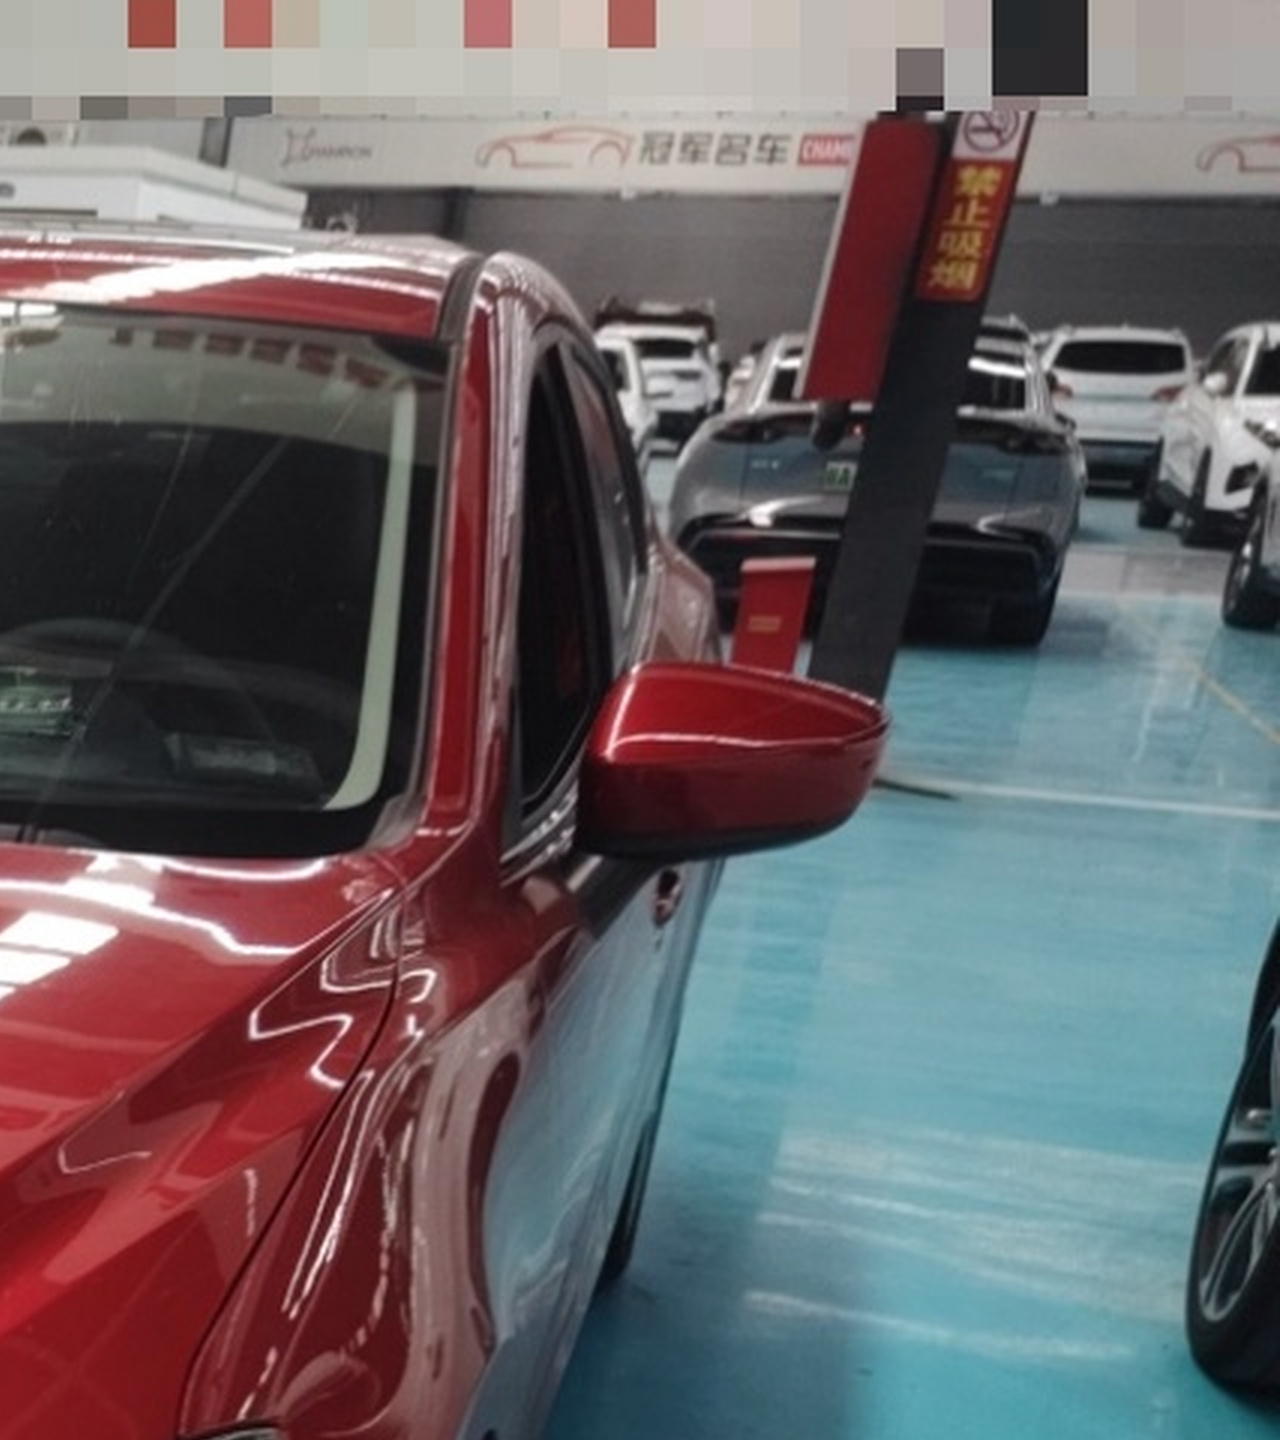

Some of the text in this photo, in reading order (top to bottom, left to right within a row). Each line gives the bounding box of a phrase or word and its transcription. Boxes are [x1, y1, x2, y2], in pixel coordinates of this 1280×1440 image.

[639, 131, 791, 167] 冠军名车
[927, 166, 1002, 289] 禁止吸烟
